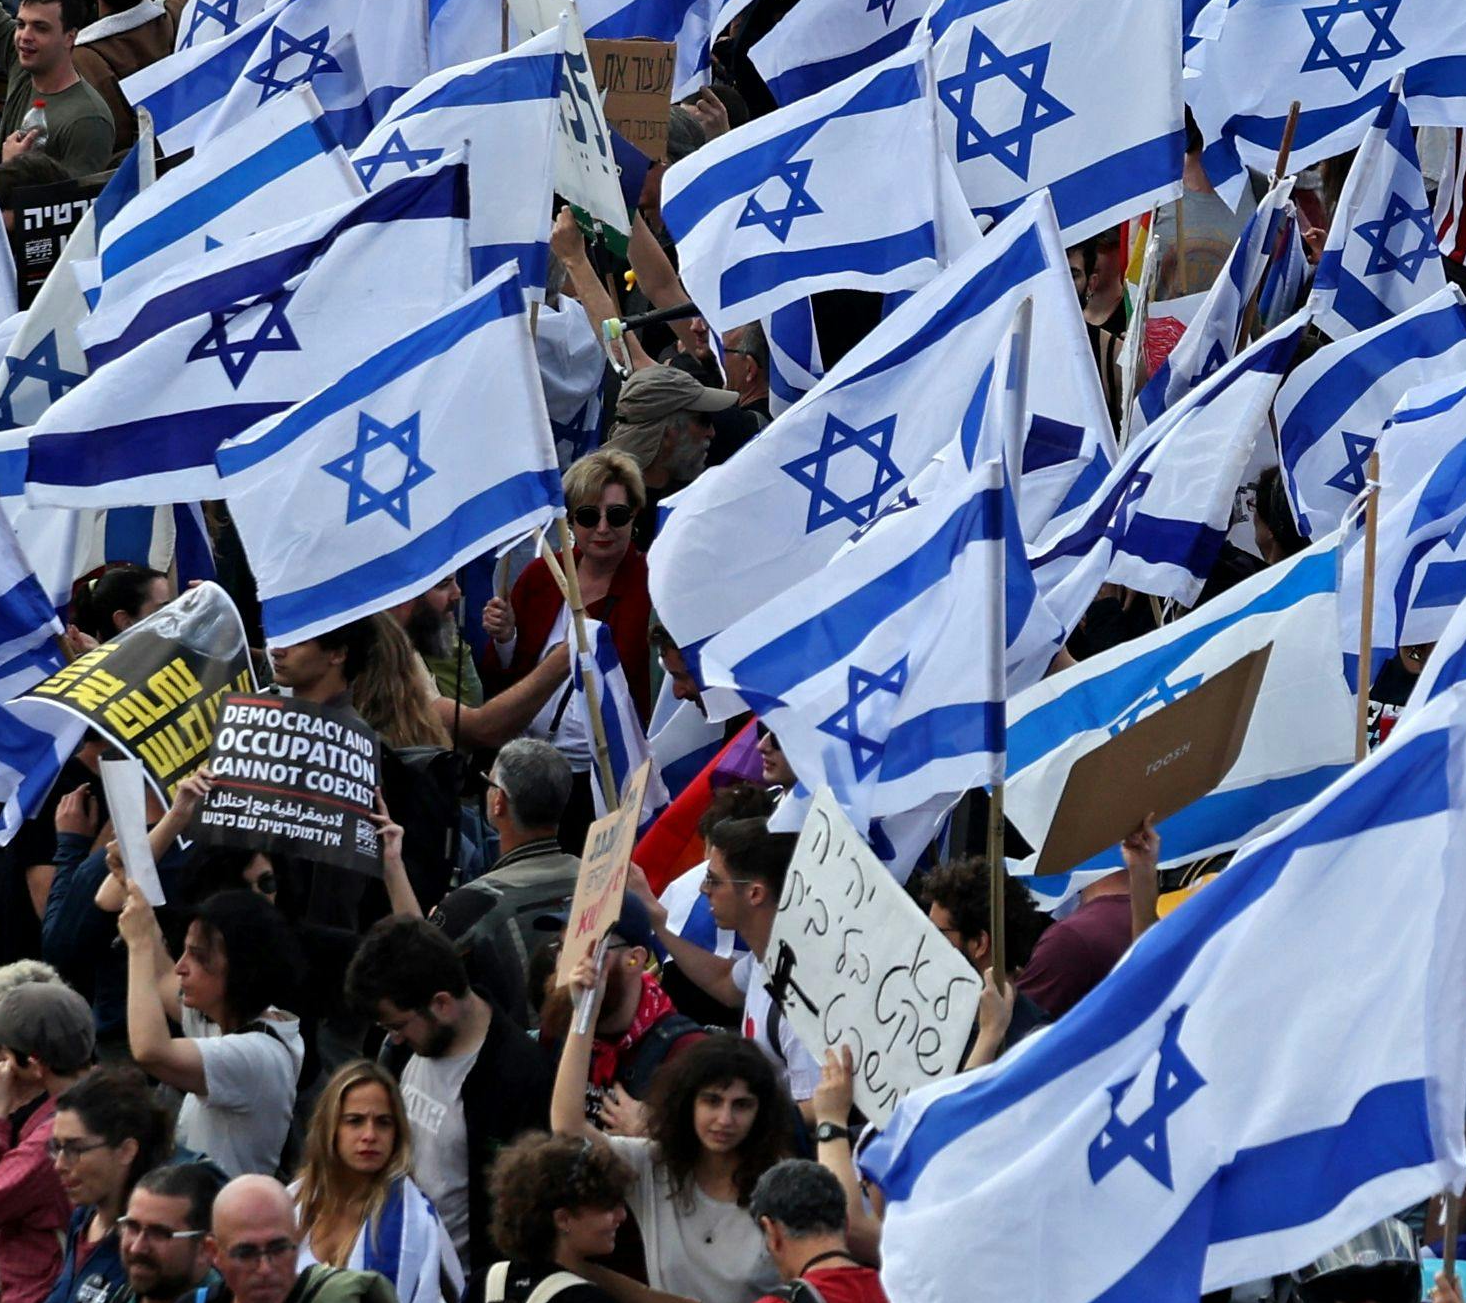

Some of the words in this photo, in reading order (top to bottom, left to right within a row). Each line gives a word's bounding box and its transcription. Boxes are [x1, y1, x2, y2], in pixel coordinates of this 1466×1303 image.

[224, 705, 342, 744] DEMOCRACY
[345, 730, 373, 757] AND
[218, 728, 376, 785] OCCUPATION
[213, 756, 302, 785] CANNOT
[306, 771, 374, 808] COEXIST
[201, 810, 237, 832] כיבוש
[238, 816, 256, 833] עם
[258, 818, 322, 844] דמוקרטיה
[324, 829, 342, 847] אין
